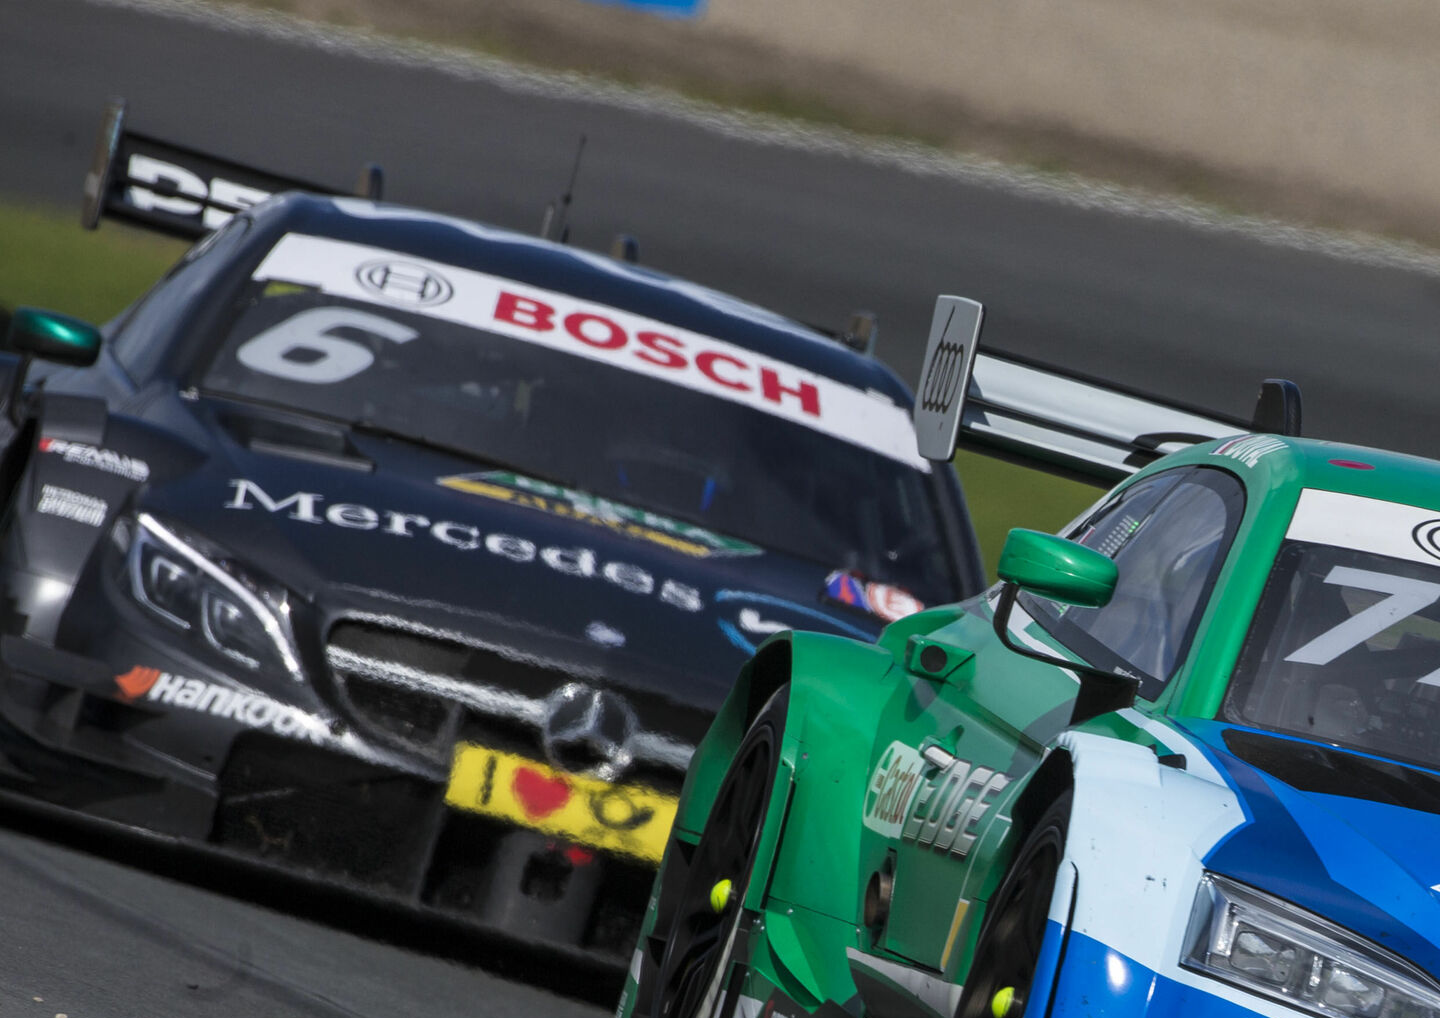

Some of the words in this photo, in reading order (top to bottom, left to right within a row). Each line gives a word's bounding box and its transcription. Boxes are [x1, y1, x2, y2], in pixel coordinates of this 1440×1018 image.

[237, 306, 420, 383] 6
[493, 291, 821, 417] BOSCH
[224, 478, 704, 612] Mercedes
[903, 746, 1010, 857] EDGE
